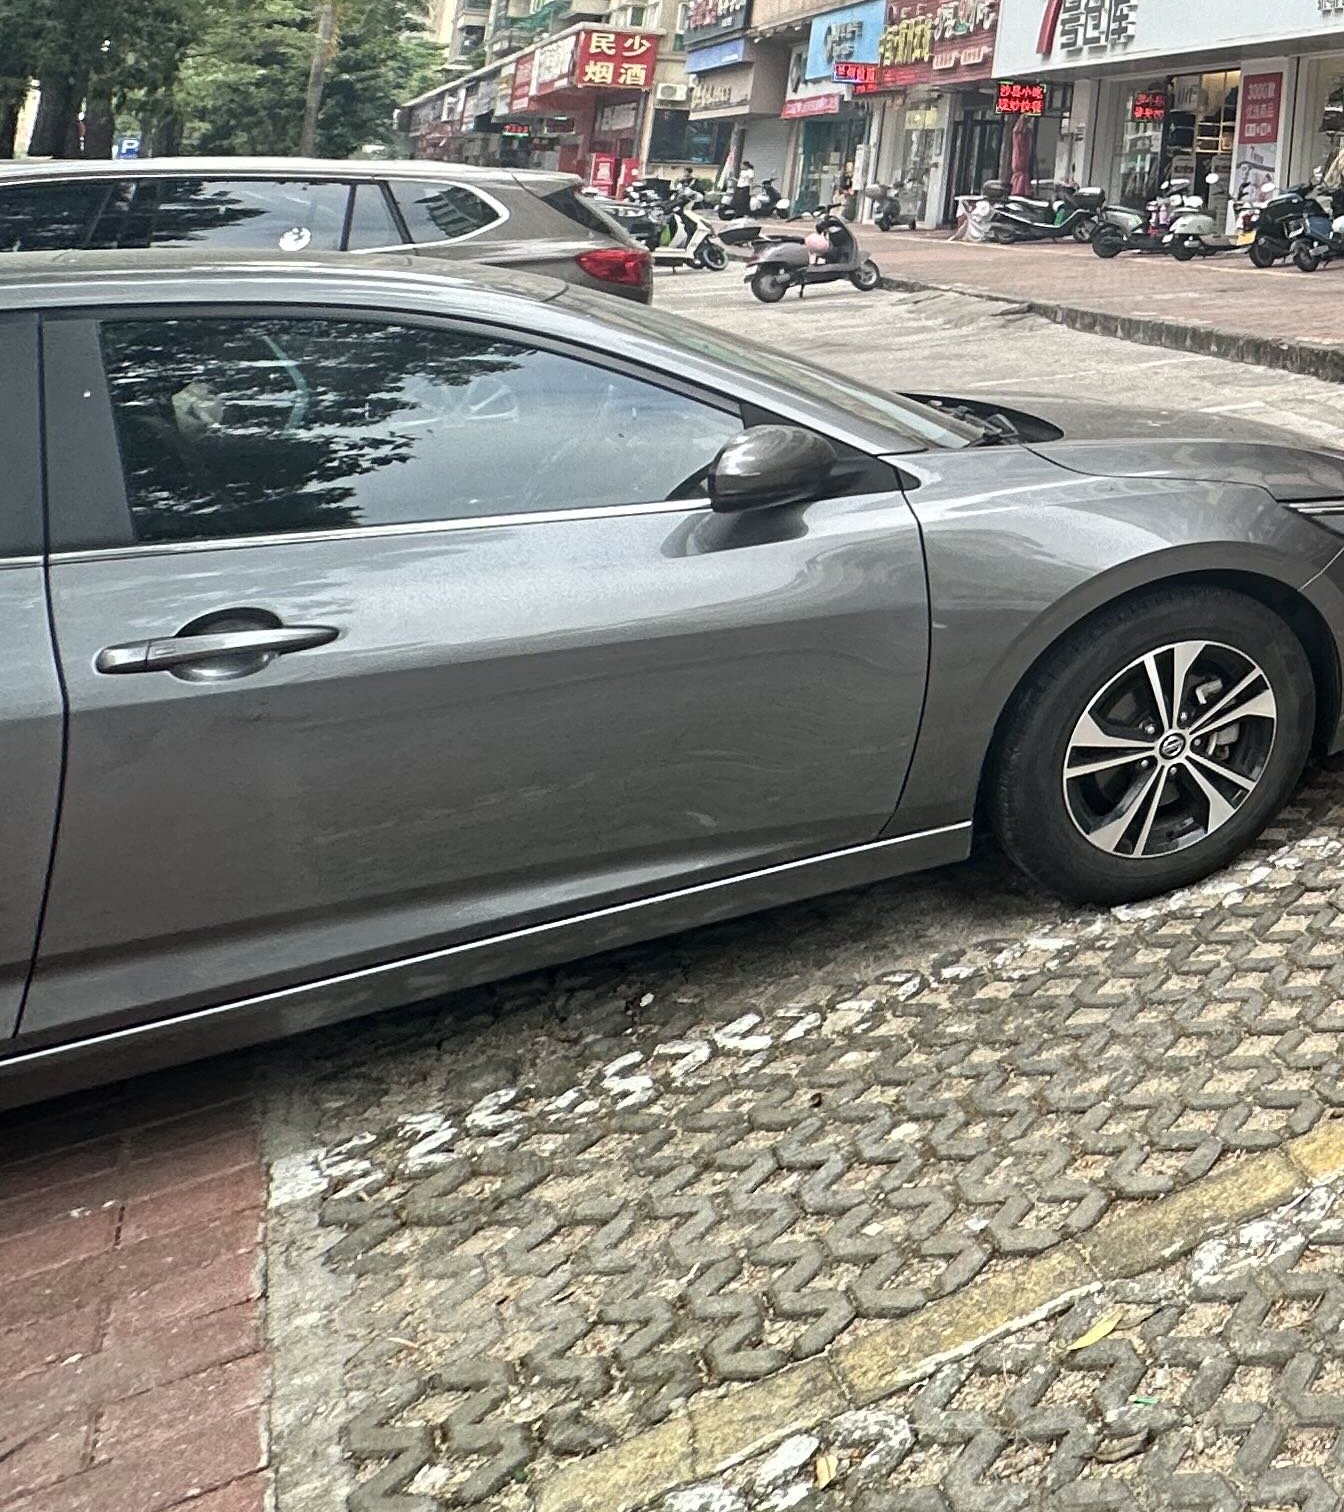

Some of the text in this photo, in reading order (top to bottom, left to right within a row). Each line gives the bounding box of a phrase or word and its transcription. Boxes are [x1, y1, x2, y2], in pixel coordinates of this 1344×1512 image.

[589, 31, 652, 57] 民少
[583, 61, 648, 86] 烟酒
[121, 139, 139, 154] P
